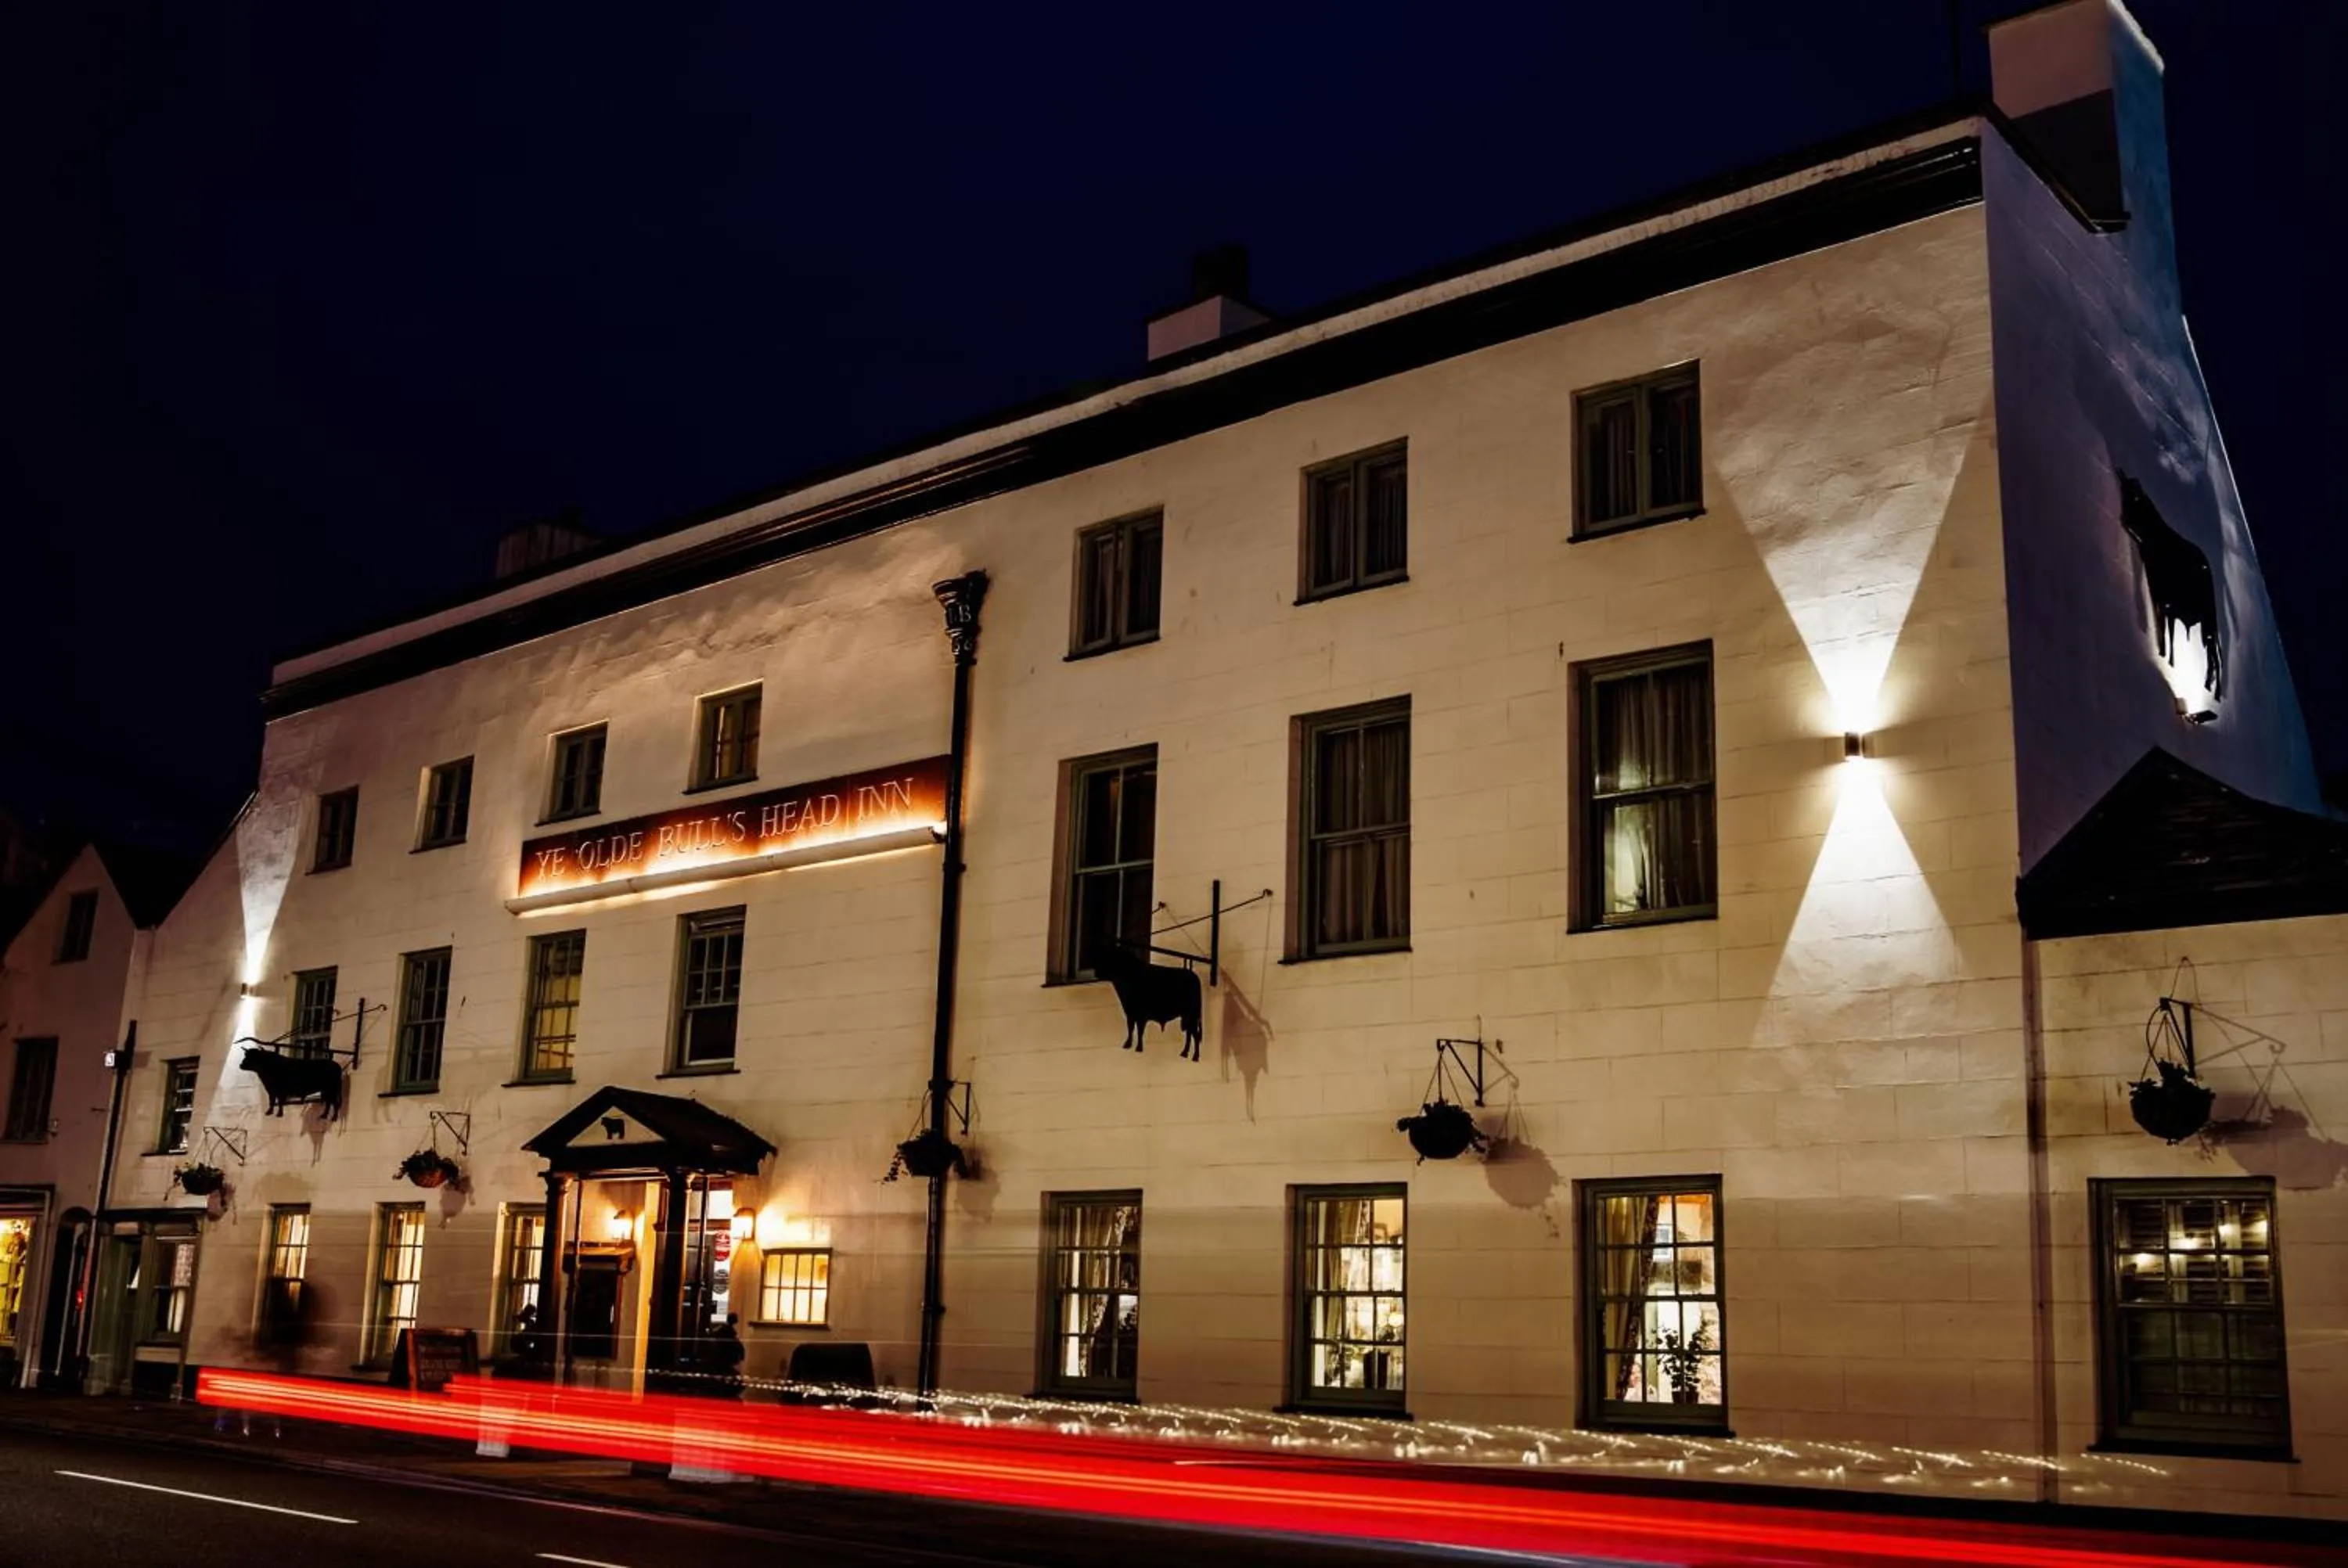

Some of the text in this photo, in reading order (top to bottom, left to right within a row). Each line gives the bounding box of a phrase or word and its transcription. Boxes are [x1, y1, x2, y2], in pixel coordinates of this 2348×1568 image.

[535, 847, 566, 880] YE
[657, 811, 746, 857] BULL'S
[759, 794, 841, 838] HEAD
[858, 778, 914, 820] INN
